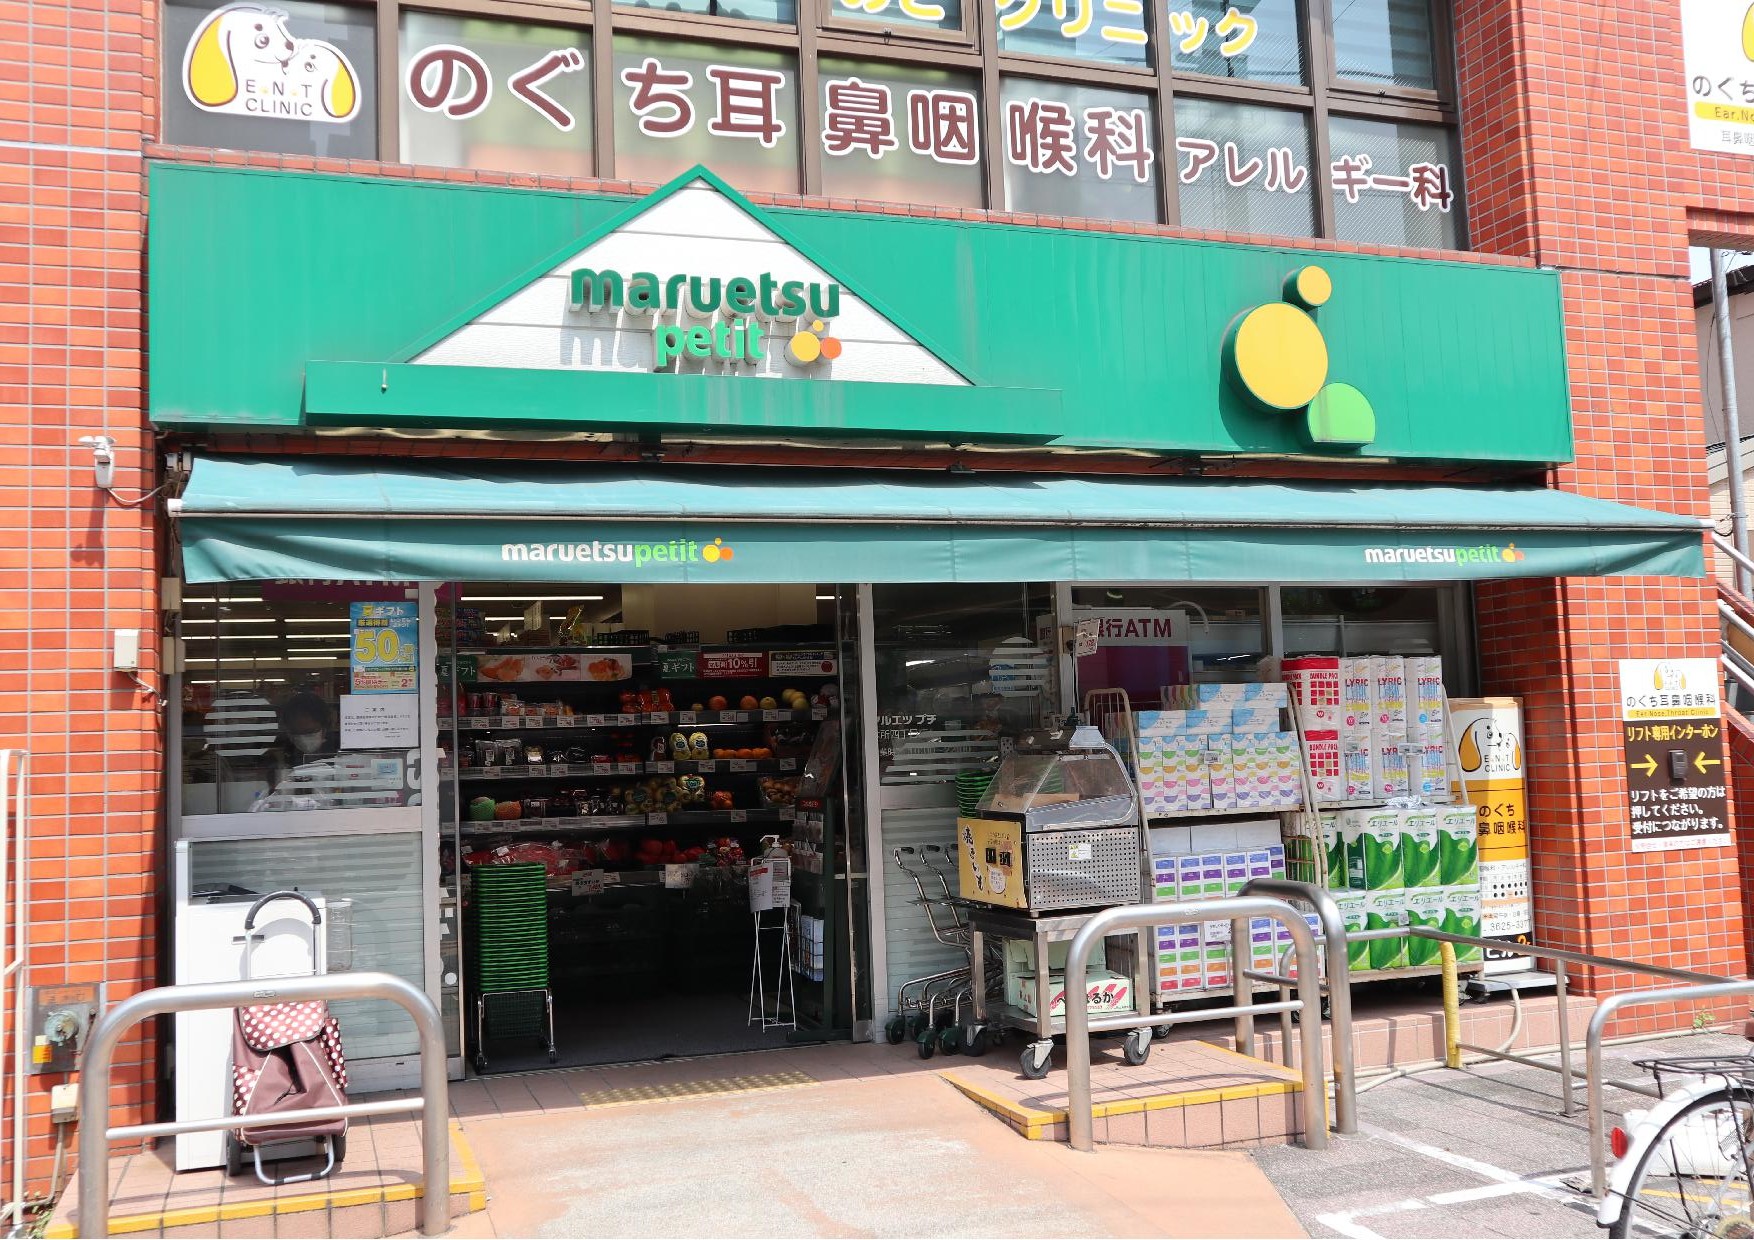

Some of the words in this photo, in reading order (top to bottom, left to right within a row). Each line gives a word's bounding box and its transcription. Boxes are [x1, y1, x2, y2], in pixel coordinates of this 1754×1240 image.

[245, 97, 313, 117] CLINIC
[1175, 138, 1453, 211] アレルギー科
[569, 267, 840, 318] maruetsu
[655, 318, 765, 367] petit
[354, 628, 400, 664] 50
[1627, 723, 1719, 743] リフト専用インターホン
[1484, 763, 1511, 773] CLINIC
[1630, 785, 1726, 803] リフトをご希望の方は
[1630, 802, 1704, 819] 押してください。
[1632, 815, 1724, 835] 受付につながります。
